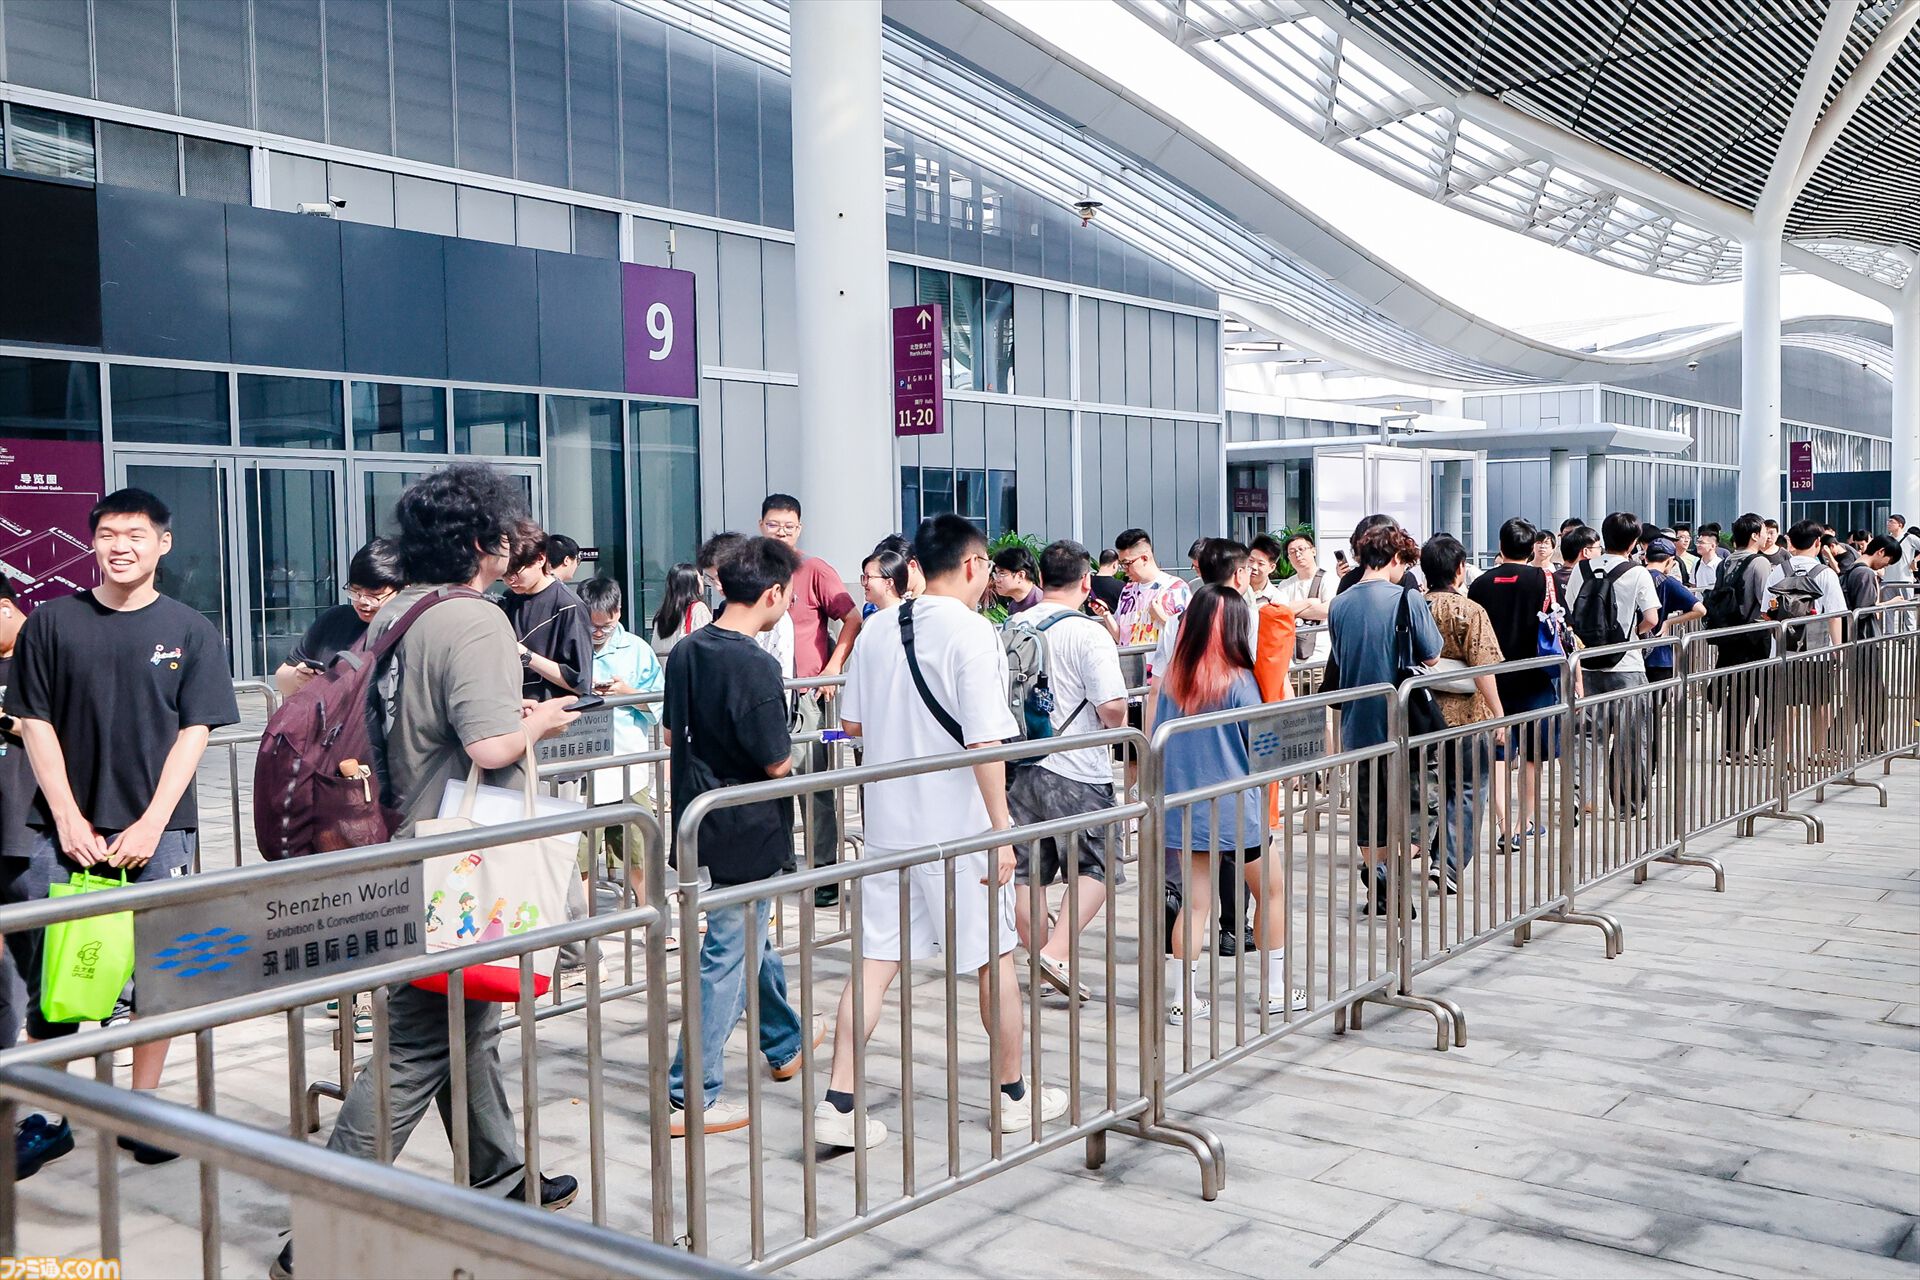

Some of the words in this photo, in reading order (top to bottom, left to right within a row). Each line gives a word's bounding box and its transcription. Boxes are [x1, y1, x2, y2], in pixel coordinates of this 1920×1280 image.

[646, 302, 674, 361] 9
[899, 408, 934, 427] 11-20
[20, 473, 57, 485] 导览图
[1792, 481, 1811, 489] 11-20
[267, 891, 352, 921] Shenzhen
[358, 877, 410, 902] World
[267, 922, 315, 940] Exhibition
[317, 918, 325, 930] &
[327, 909, 379, 928] Convention
[380, 904, 410, 919] Center
[262, 921, 418, 977] 深圳国际会展中心
